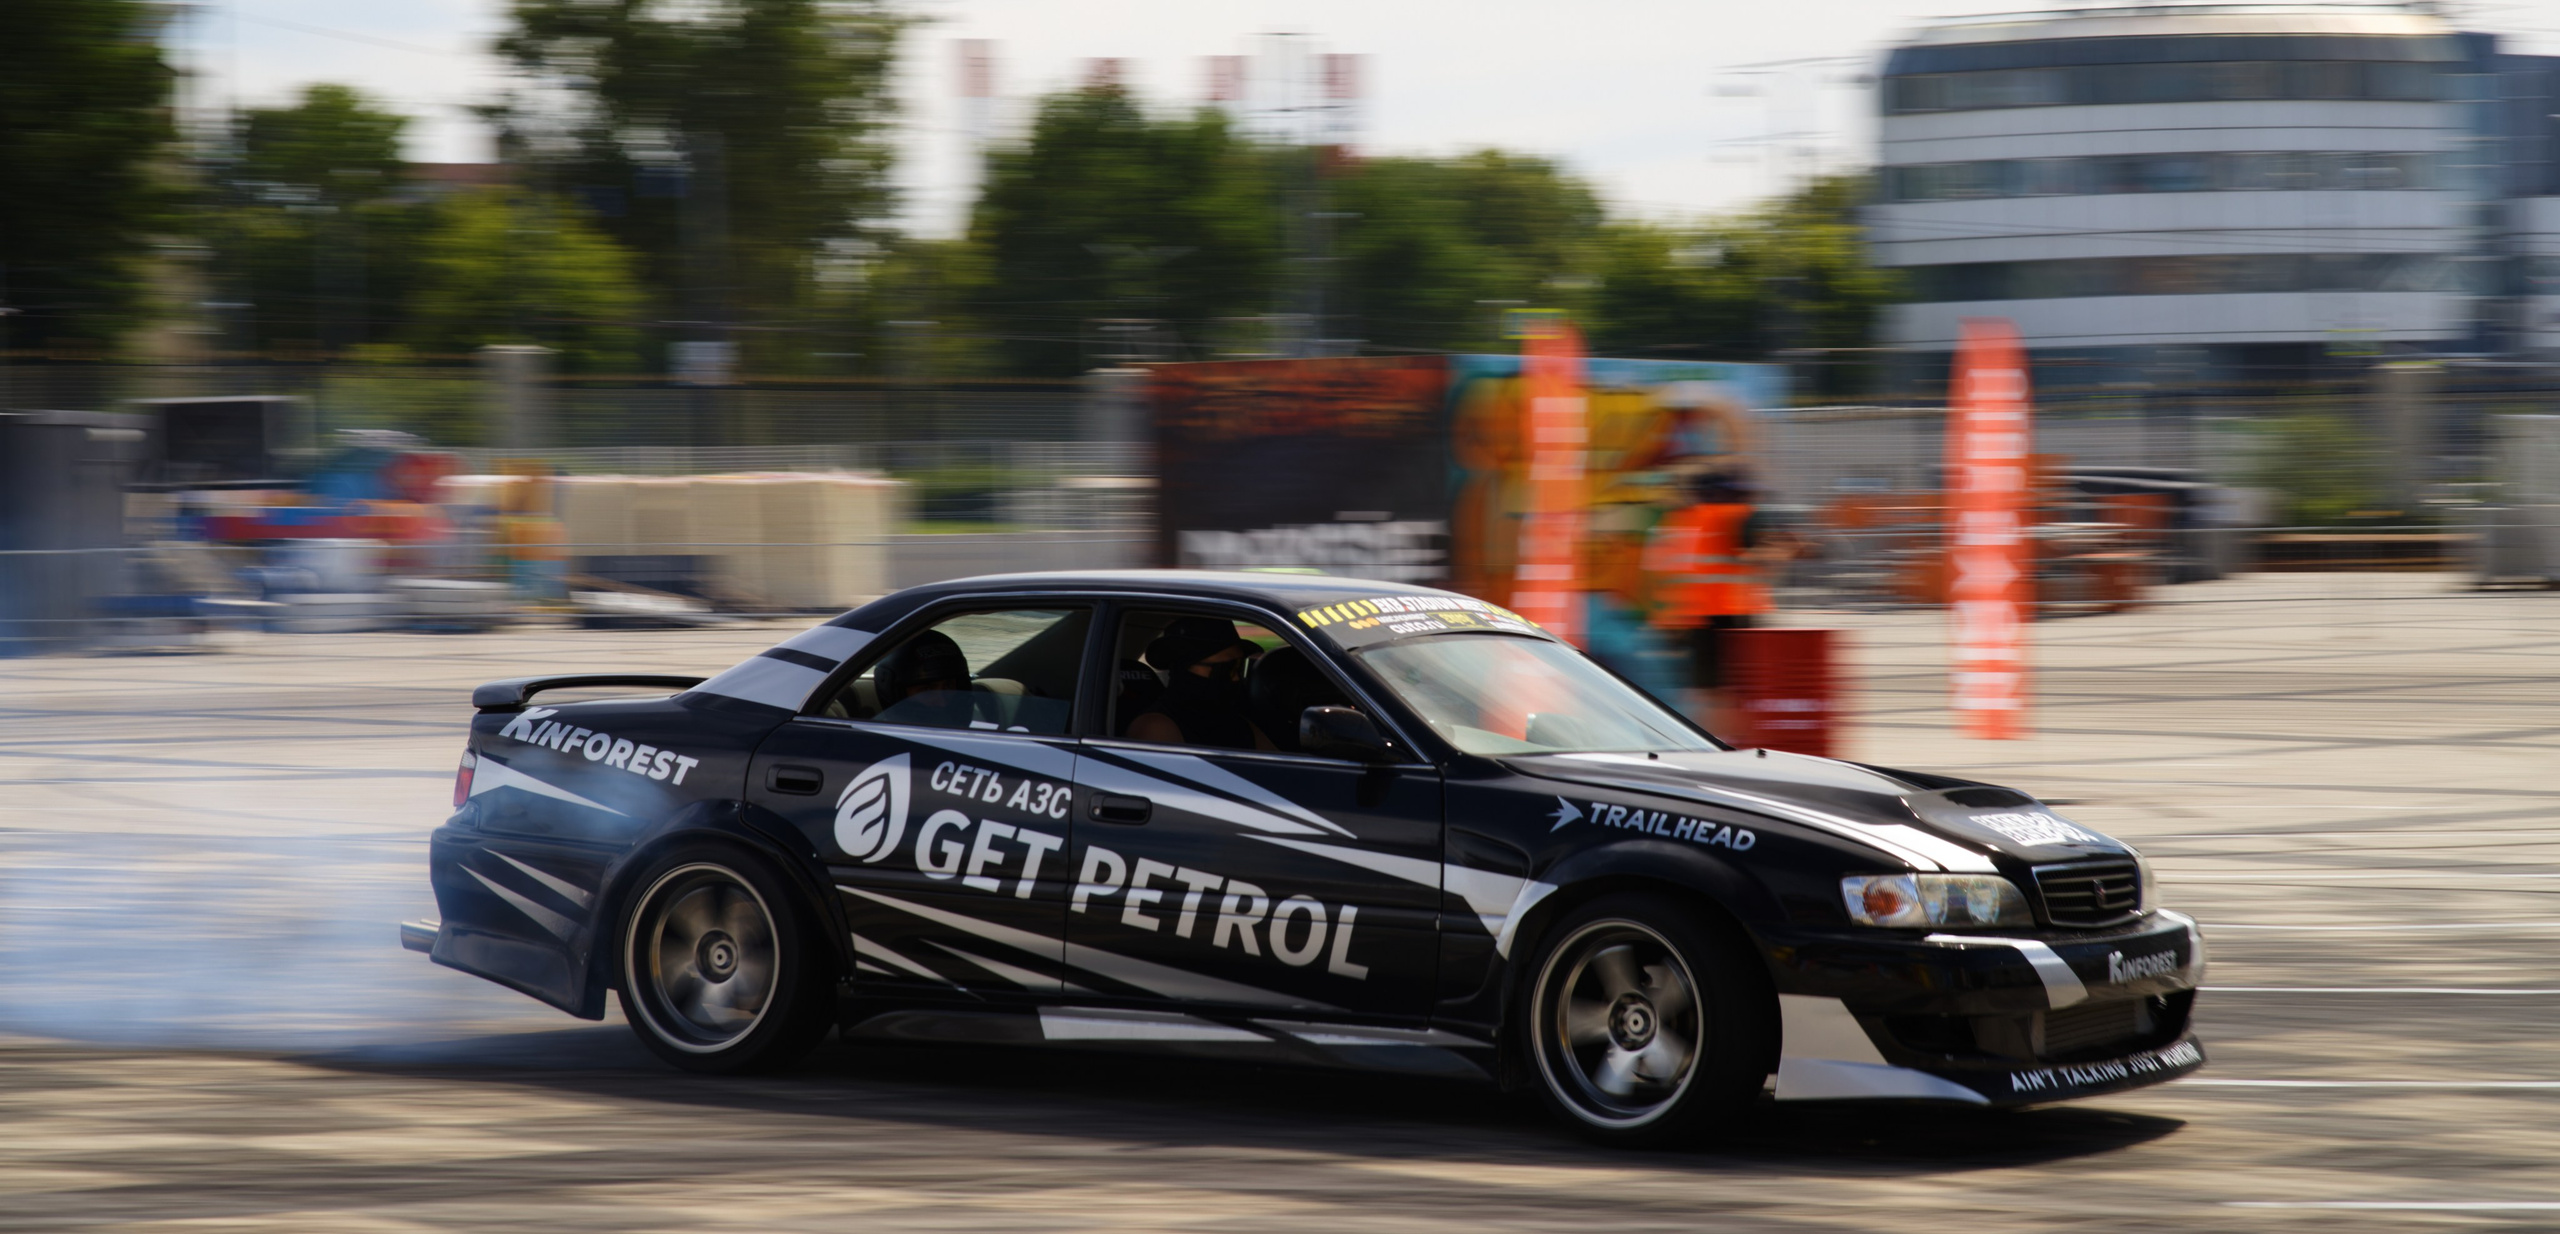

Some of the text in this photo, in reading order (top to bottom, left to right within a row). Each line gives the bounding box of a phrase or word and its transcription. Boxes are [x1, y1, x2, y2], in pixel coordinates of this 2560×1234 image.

[1389, 620, 1448, 634] auto.ru
[498, 707, 699, 786] KINFOREST
[930, 761, 1073, 820] СЕТЬ АЗС
[1590, 802, 1756, 851] TRAILHEAD
[915, 809, 1370, 981] GET PETROL
[2108, 950, 2178, 984] KINFOREST
[2010, 1069, 2058, 1092] AIN'T
[2058, 1062, 2129, 1087] TALKING
[2129, 1055, 2162, 1075] JUST
